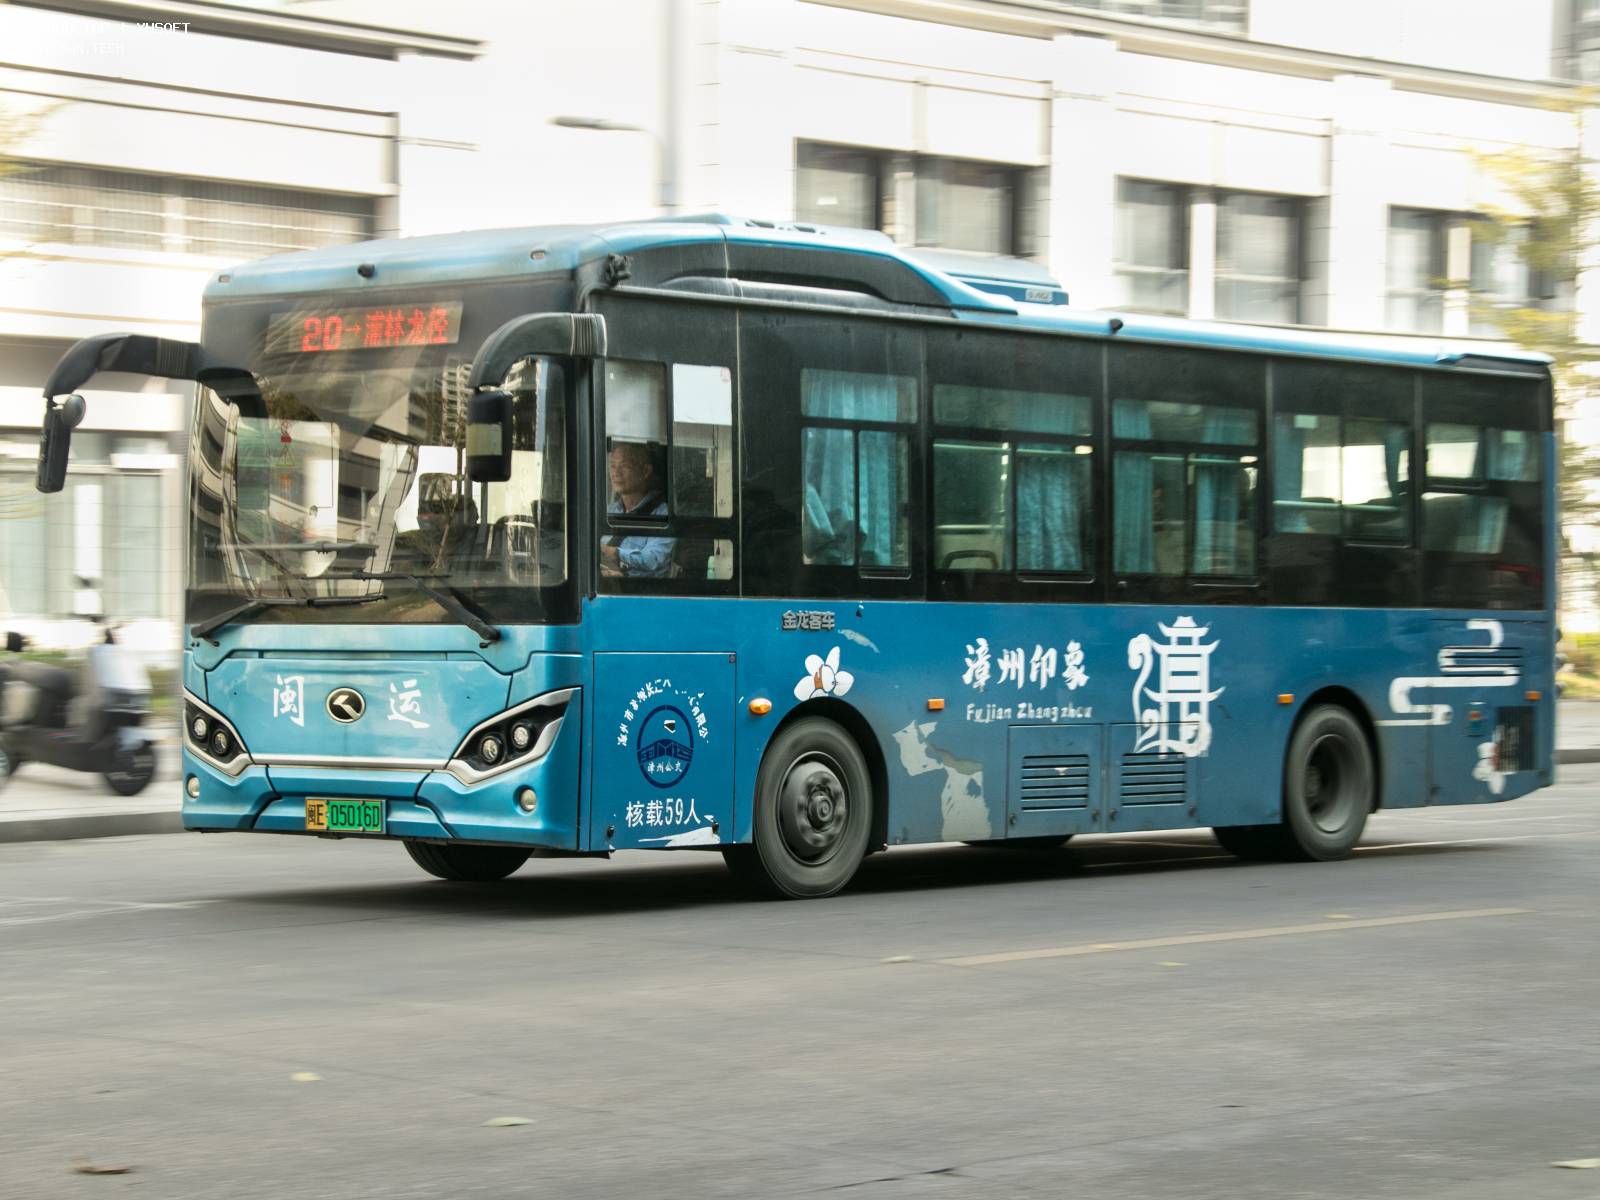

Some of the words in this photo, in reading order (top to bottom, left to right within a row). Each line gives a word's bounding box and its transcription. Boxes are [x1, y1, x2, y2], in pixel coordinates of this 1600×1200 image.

[302, 315, 343, 352] 20
[782, 609, 836, 630] 金龙客车
[962, 637, 1090, 692] 漳州印象
[273, 674, 306, 728] 闽
[388, 678, 430, 729] 运
[966, 703, 1012, 723] Fujian
[625, 798, 701, 828] 核载59人
